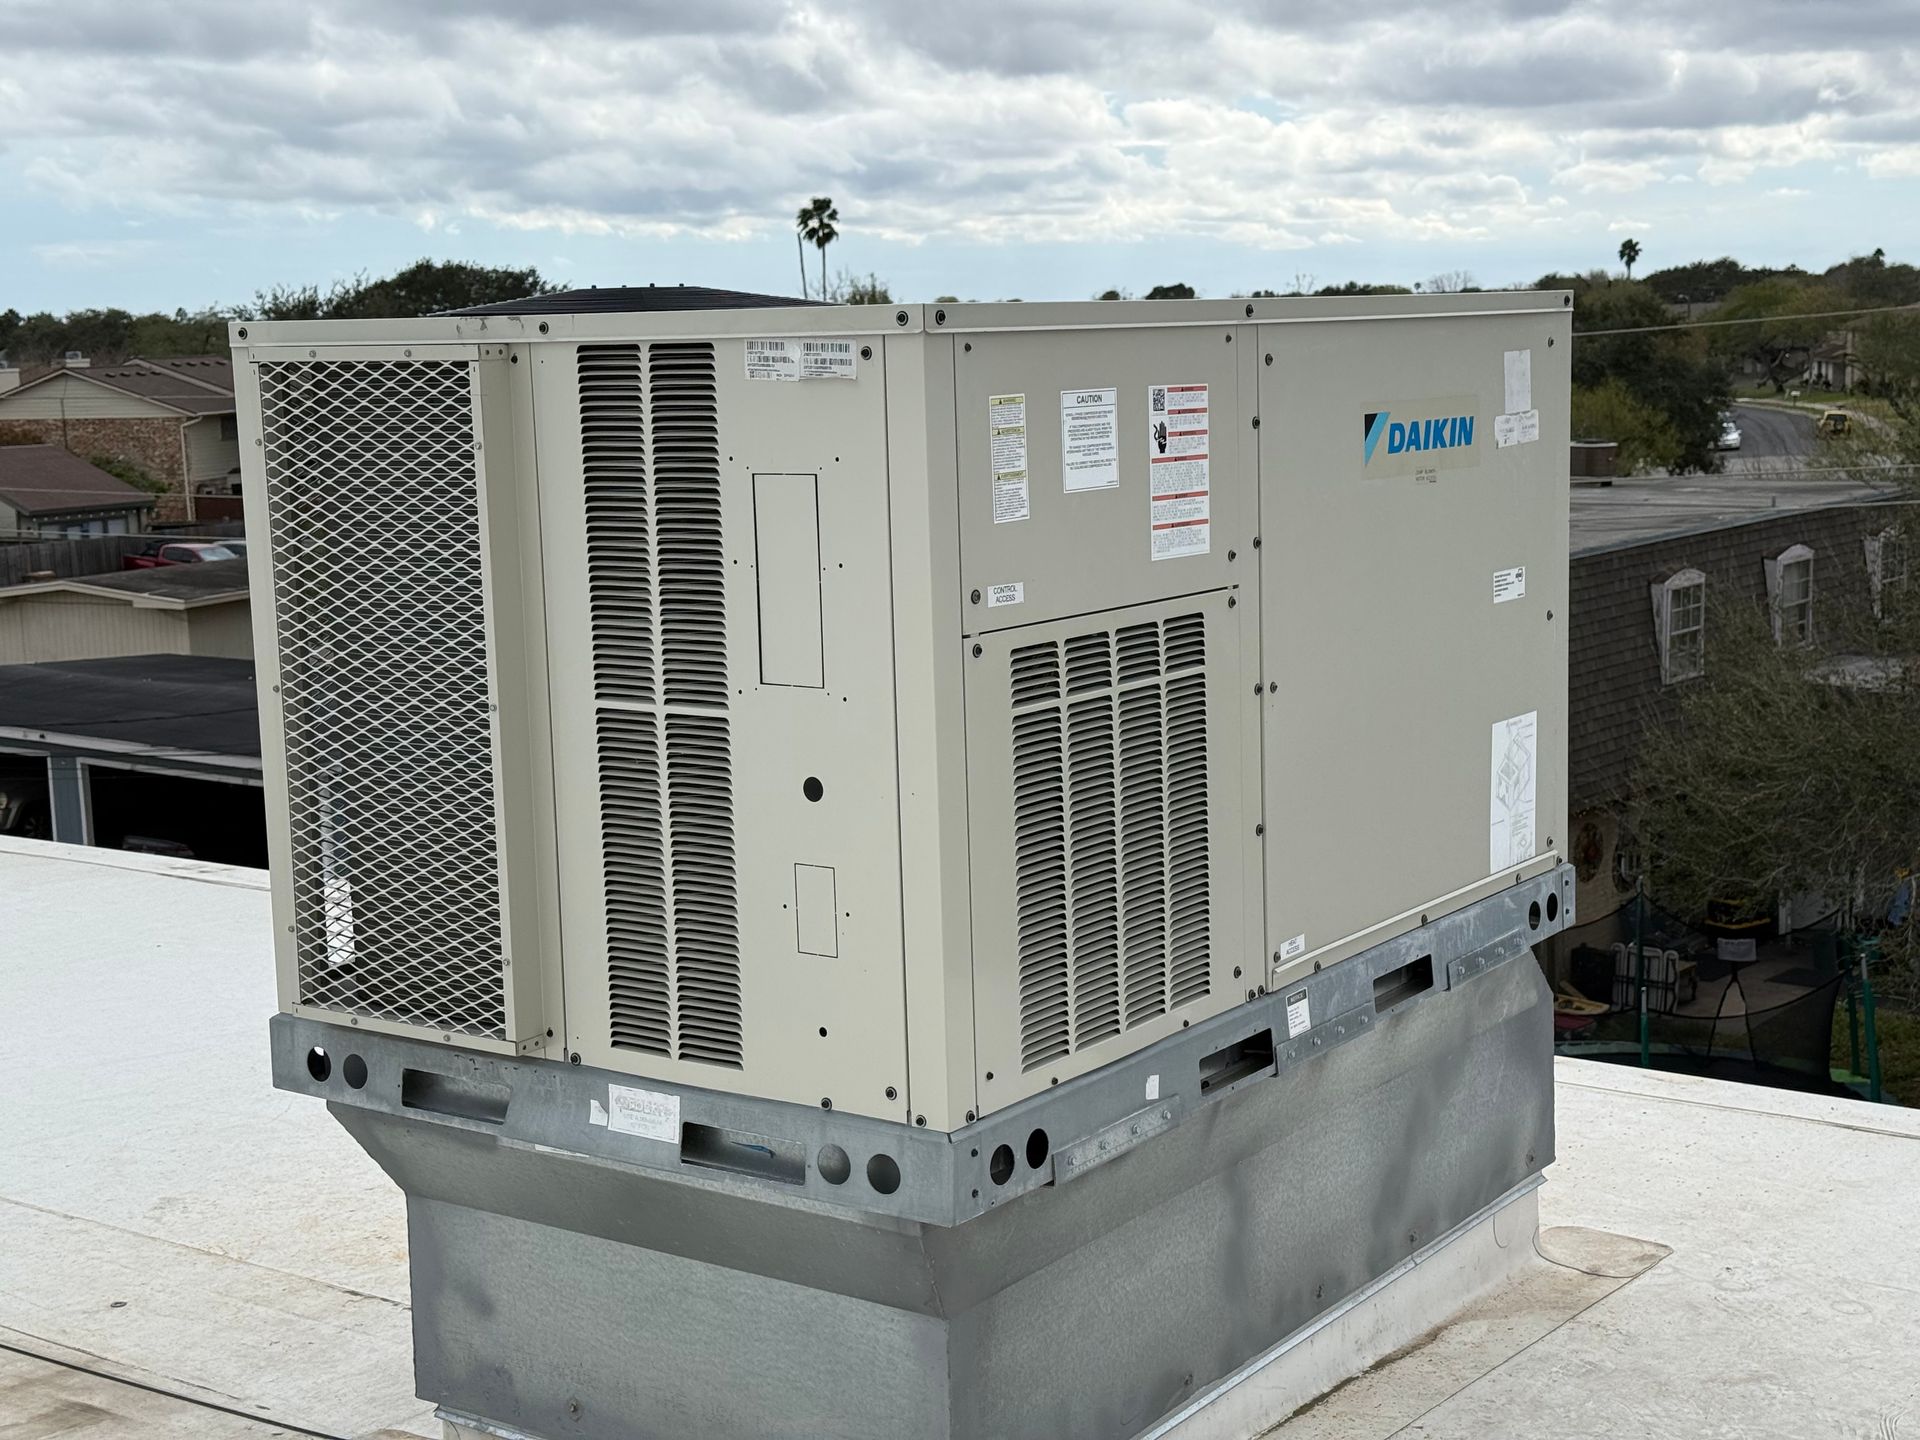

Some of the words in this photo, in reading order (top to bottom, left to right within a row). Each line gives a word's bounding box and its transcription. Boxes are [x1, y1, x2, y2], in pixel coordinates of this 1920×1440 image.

[1077, 394, 1102, 404] CAUTION
[1388, 416, 1474, 454] DAIKIN
[993, 585, 1017, 595] CONTROL
[996, 594, 1016, 603] ACCESS
